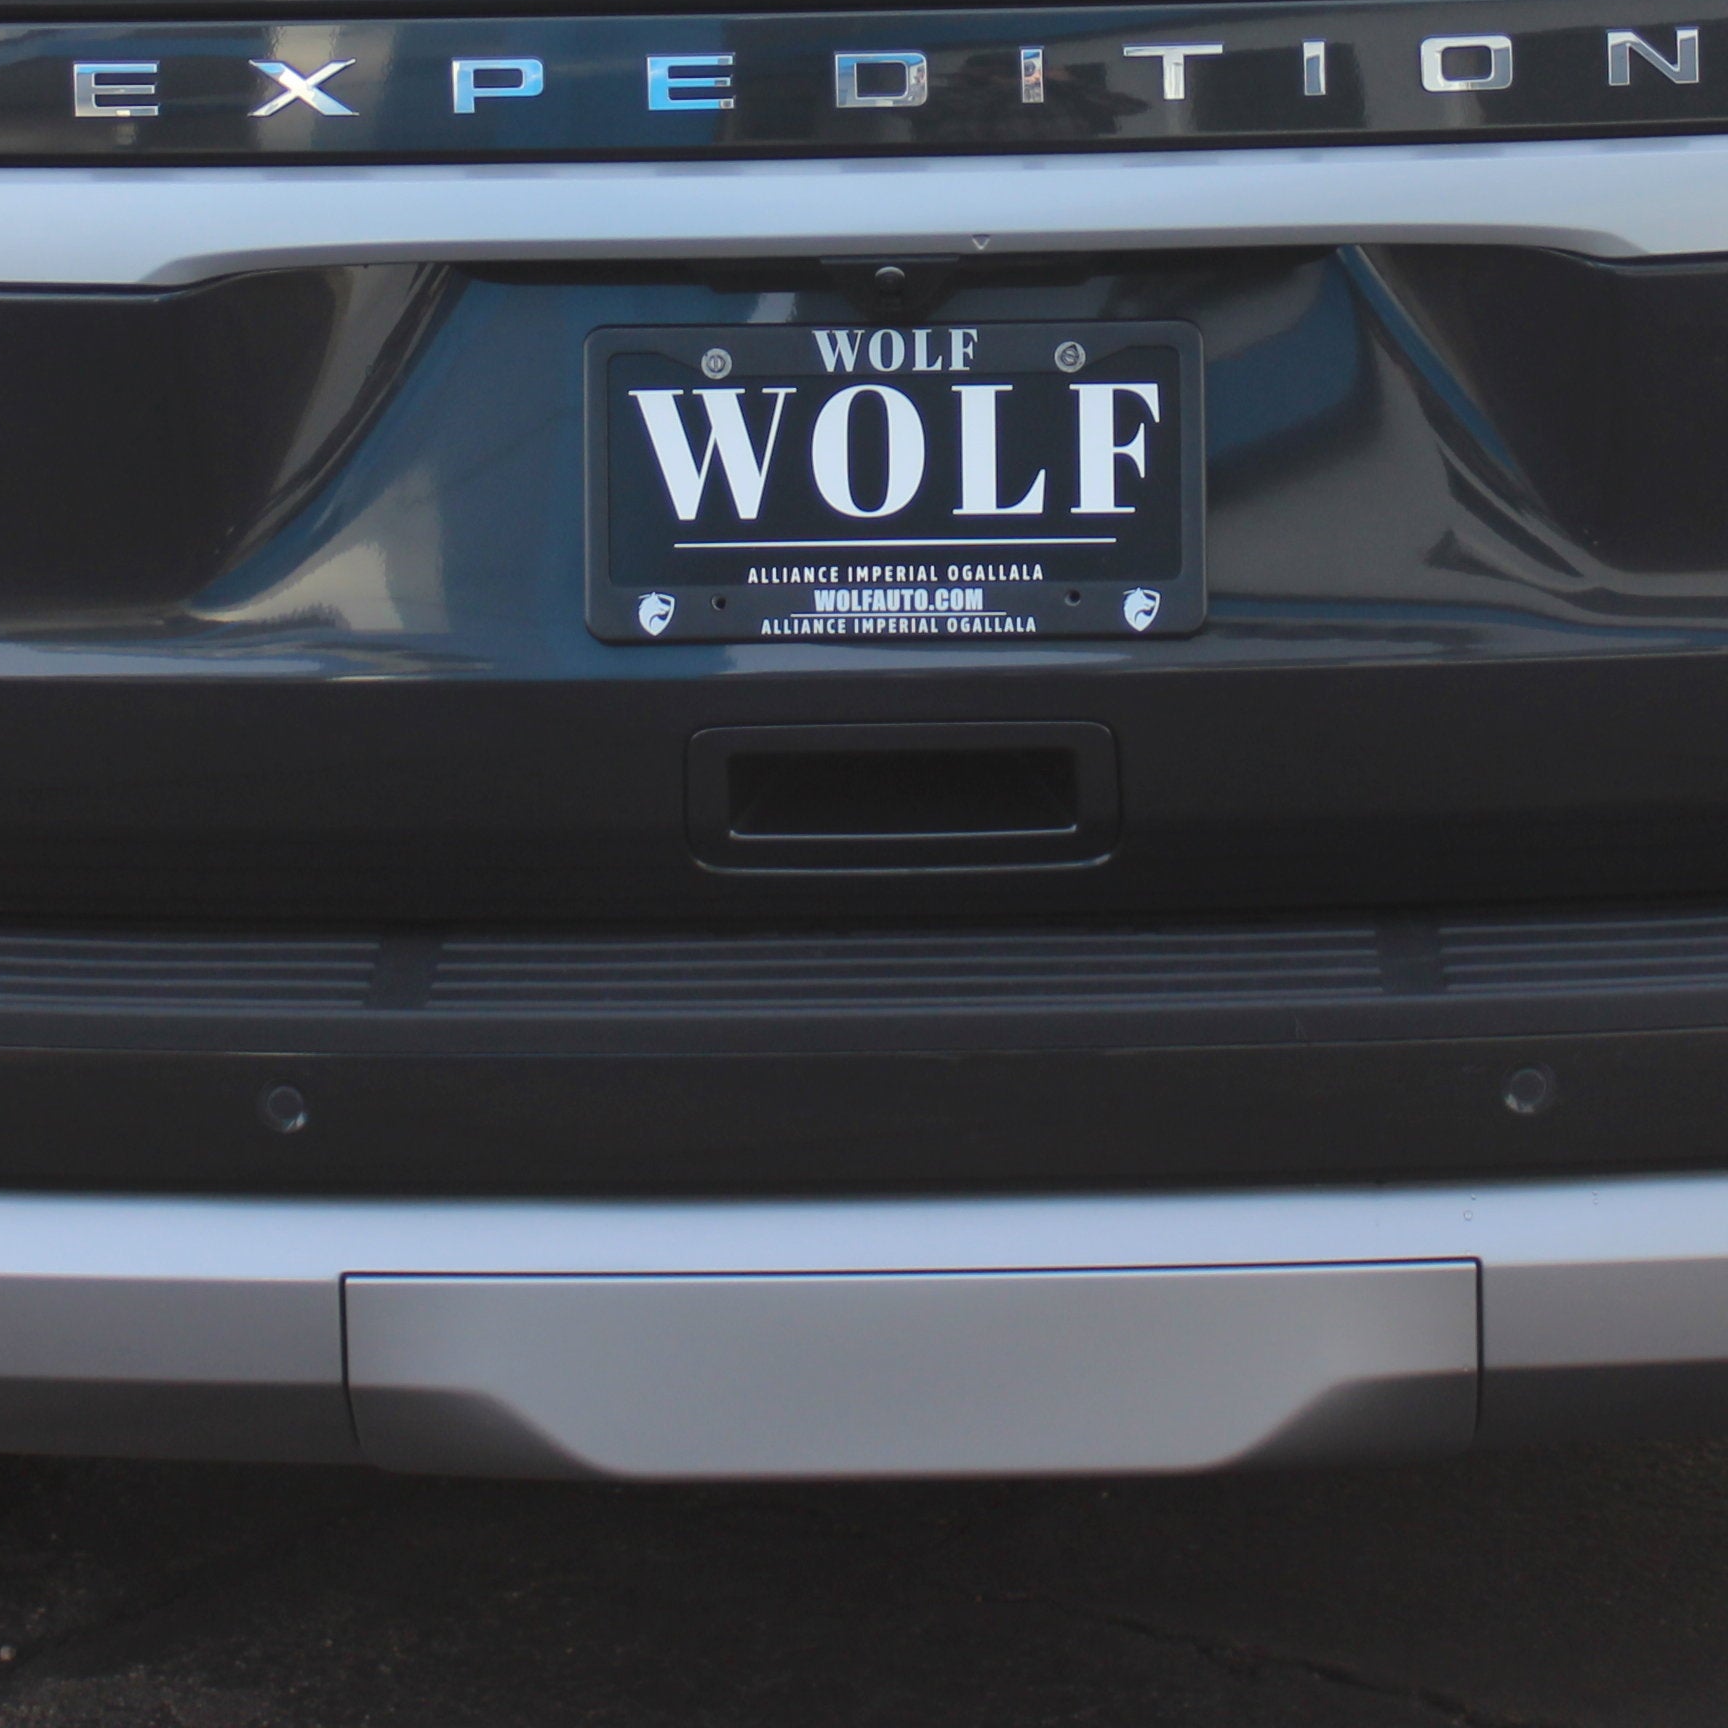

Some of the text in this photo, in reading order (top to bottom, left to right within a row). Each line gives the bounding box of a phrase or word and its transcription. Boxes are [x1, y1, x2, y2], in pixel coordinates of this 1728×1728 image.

[73, 27, 1700, 117] EXPEDITION
[812, 328, 978, 373] WOLF
[628, 382, 1161, 521] WOLF
[747, 564, 1044, 584] ALLIANCE IMPERIAL OGALLALA
[813, 588, 984, 612] WOLFAUTO.COM
[761, 616, 1037, 635] ALLIANCE IMPERIAL OGALLALA
